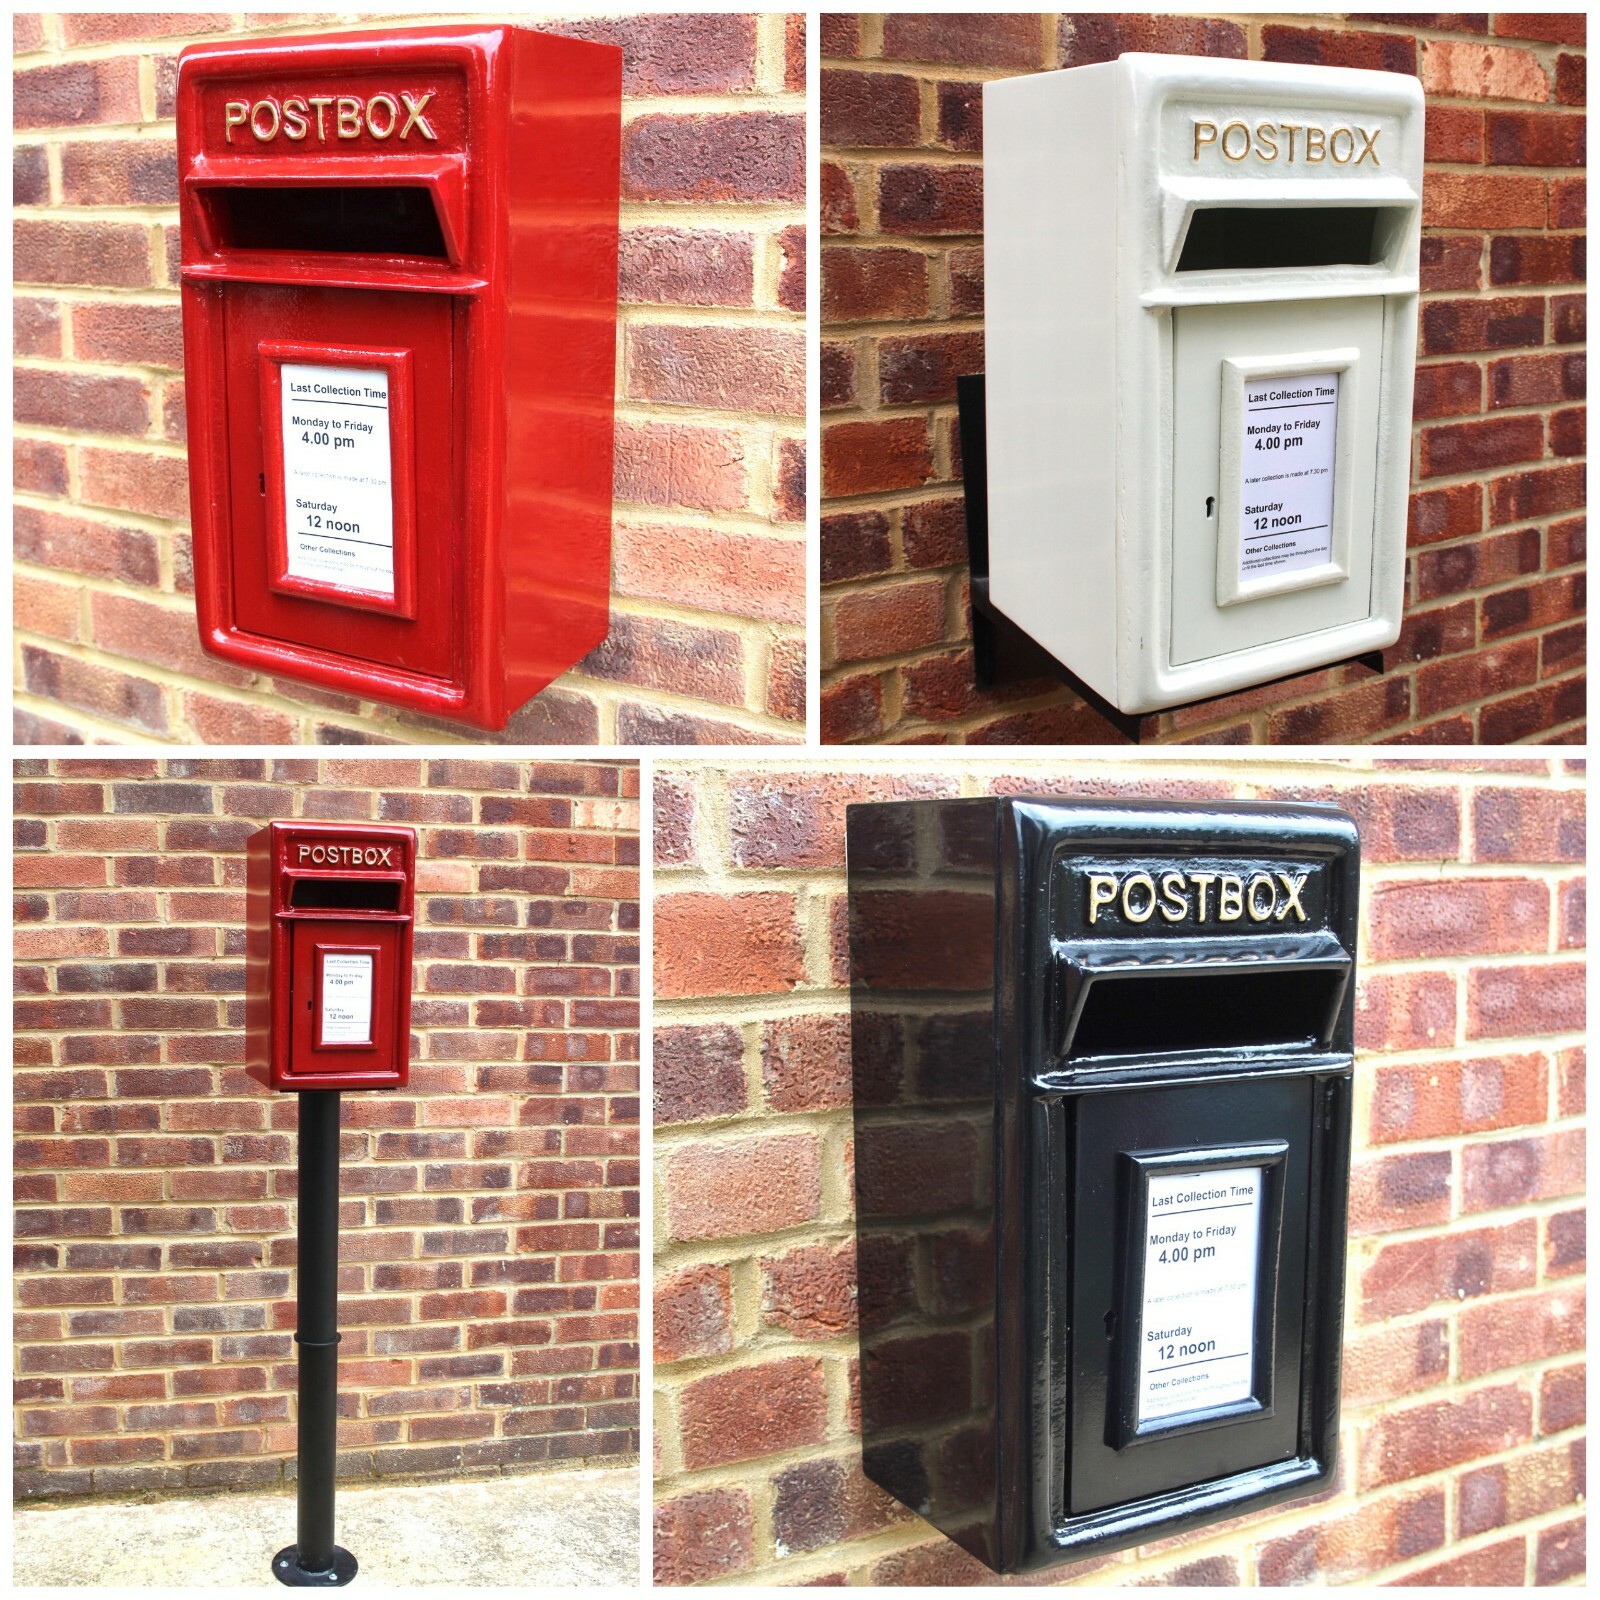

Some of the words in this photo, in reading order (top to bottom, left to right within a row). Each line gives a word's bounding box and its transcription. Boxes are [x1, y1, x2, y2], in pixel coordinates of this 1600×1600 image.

[225, 90, 437, 144] POSTBOX
[1193, 120, 1381, 166] POSTBOX
[290, 383, 311, 394] Last
[314, 384, 361, 397] Collection
[364, 388, 387, 399] Time
[1248, 393, 1268, 403] Last
[1270, 389, 1313, 401] Collection
[1315, 388, 1335, 397] Time
[292, 416, 329, 430] Monday
[332, 419, 342, 428] to
[345, 420, 373, 434] Friday
[1248, 424, 1282, 435] Monday
[1284, 423, 1292, 431] to
[1295, 420, 1321, 430] Friday
[302, 431, 329, 446] 4.00
[334, 436, 355, 449] pm
[1255, 437, 1280, 451] 4.00
[1284, 436, 1303, 450] pm
[1262, 474, 1285, 482] collection
[296, 498, 338, 514] Saturday
[1245, 502, 1284, 515] Saturday
[306, 514, 322, 529] 12
[326, 519, 360, 534] noon
[1254, 517, 1268, 531] 12
[1272, 514, 1302, 528] noon
[300, 543, 318, 551] Other
[320, 546, 356, 557] Collections
[1245, 547, 1263, 555] Other
[1264, 541, 1297, 552] Collections
[298, 846, 392, 866] POSTBOX
[1089, 874, 1308, 924] POSTBOX
[1152, 1196, 1173, 1207] Last
[1177, 1189, 1227, 1204] Collection
[1230, 1186, 1254, 1197] Time
[1150, 1231, 1190, 1245] Monday
[1193, 1229, 1203, 1239] to
[1206, 1225, 1237, 1238] Friday
[1159, 1247, 1189, 1264] 4.00
[1194, 1245, 1215, 1263] pm
[1147, 1326, 1193, 1342] Saturday
[1158, 1344, 1175, 1361] 12
[1179, 1340, 1216, 1357] noon
[1150, 1381, 1169, 1391] Other
[1171, 1372, 1210, 1386] Collections
